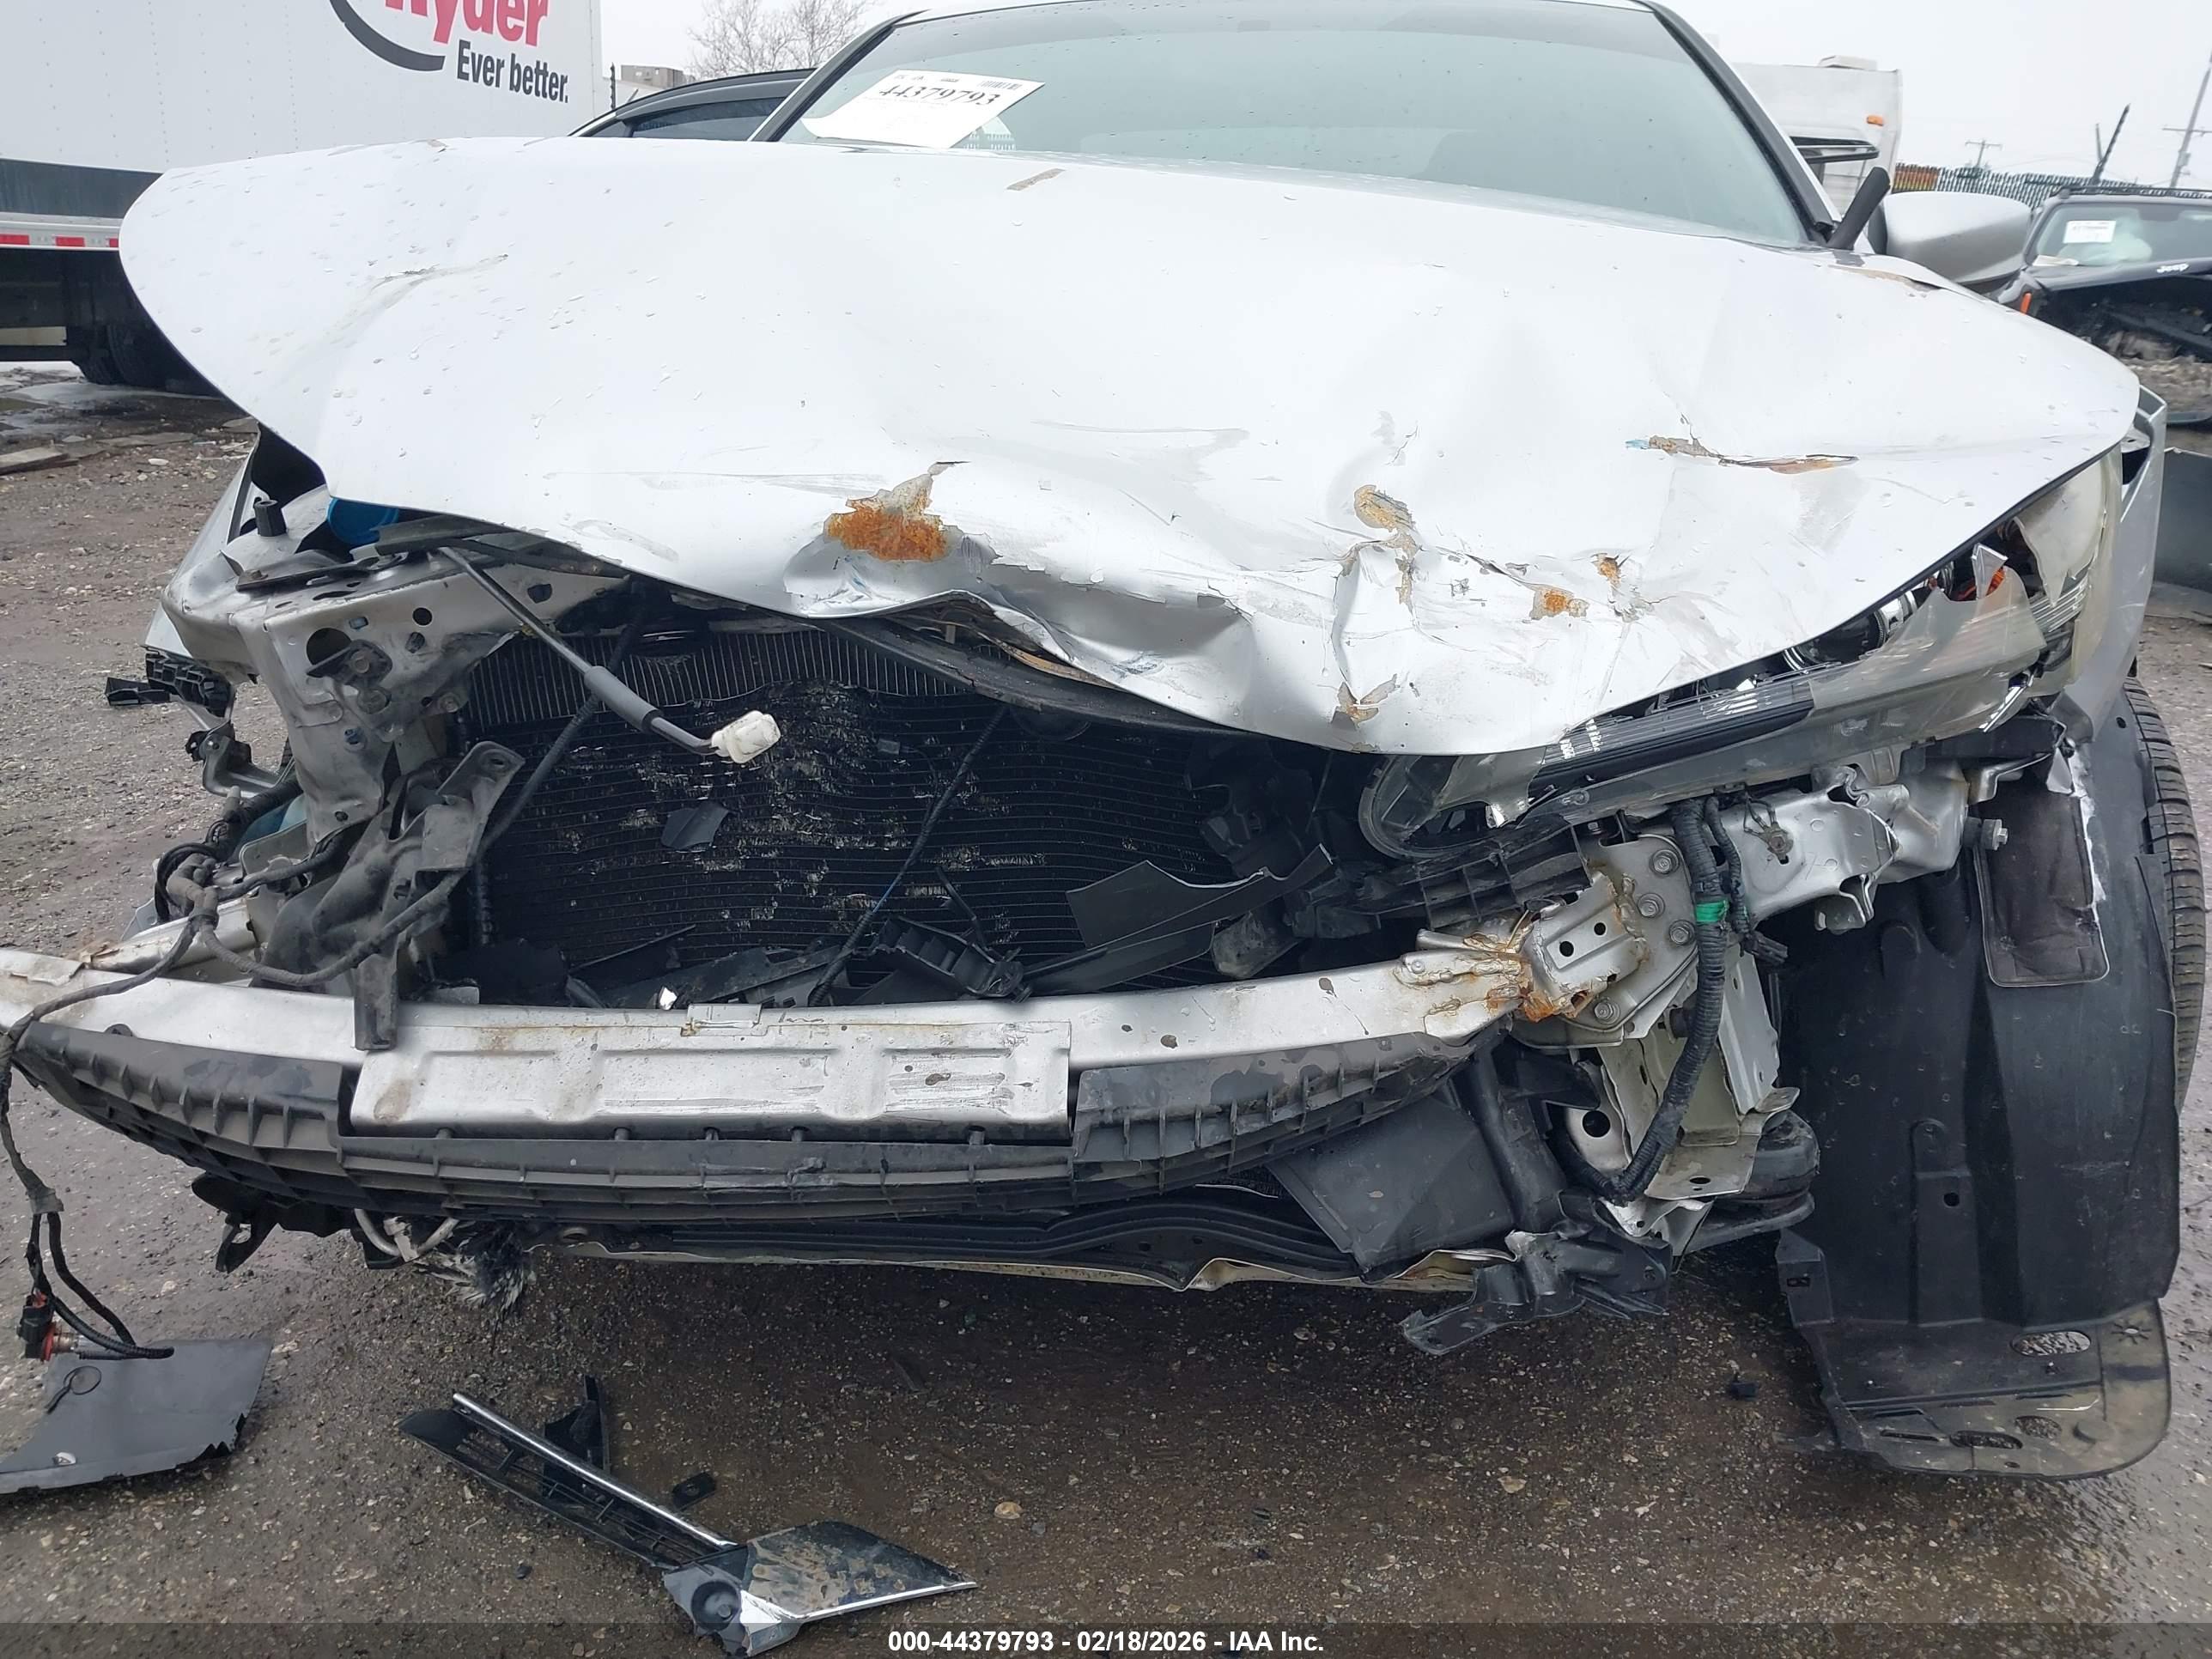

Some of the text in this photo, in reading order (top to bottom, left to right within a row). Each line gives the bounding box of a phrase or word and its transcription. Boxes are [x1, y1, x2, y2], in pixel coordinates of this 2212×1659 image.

[457, 39, 568, 104] Ever better.
[878, 84, 1001, 106] 44379793
